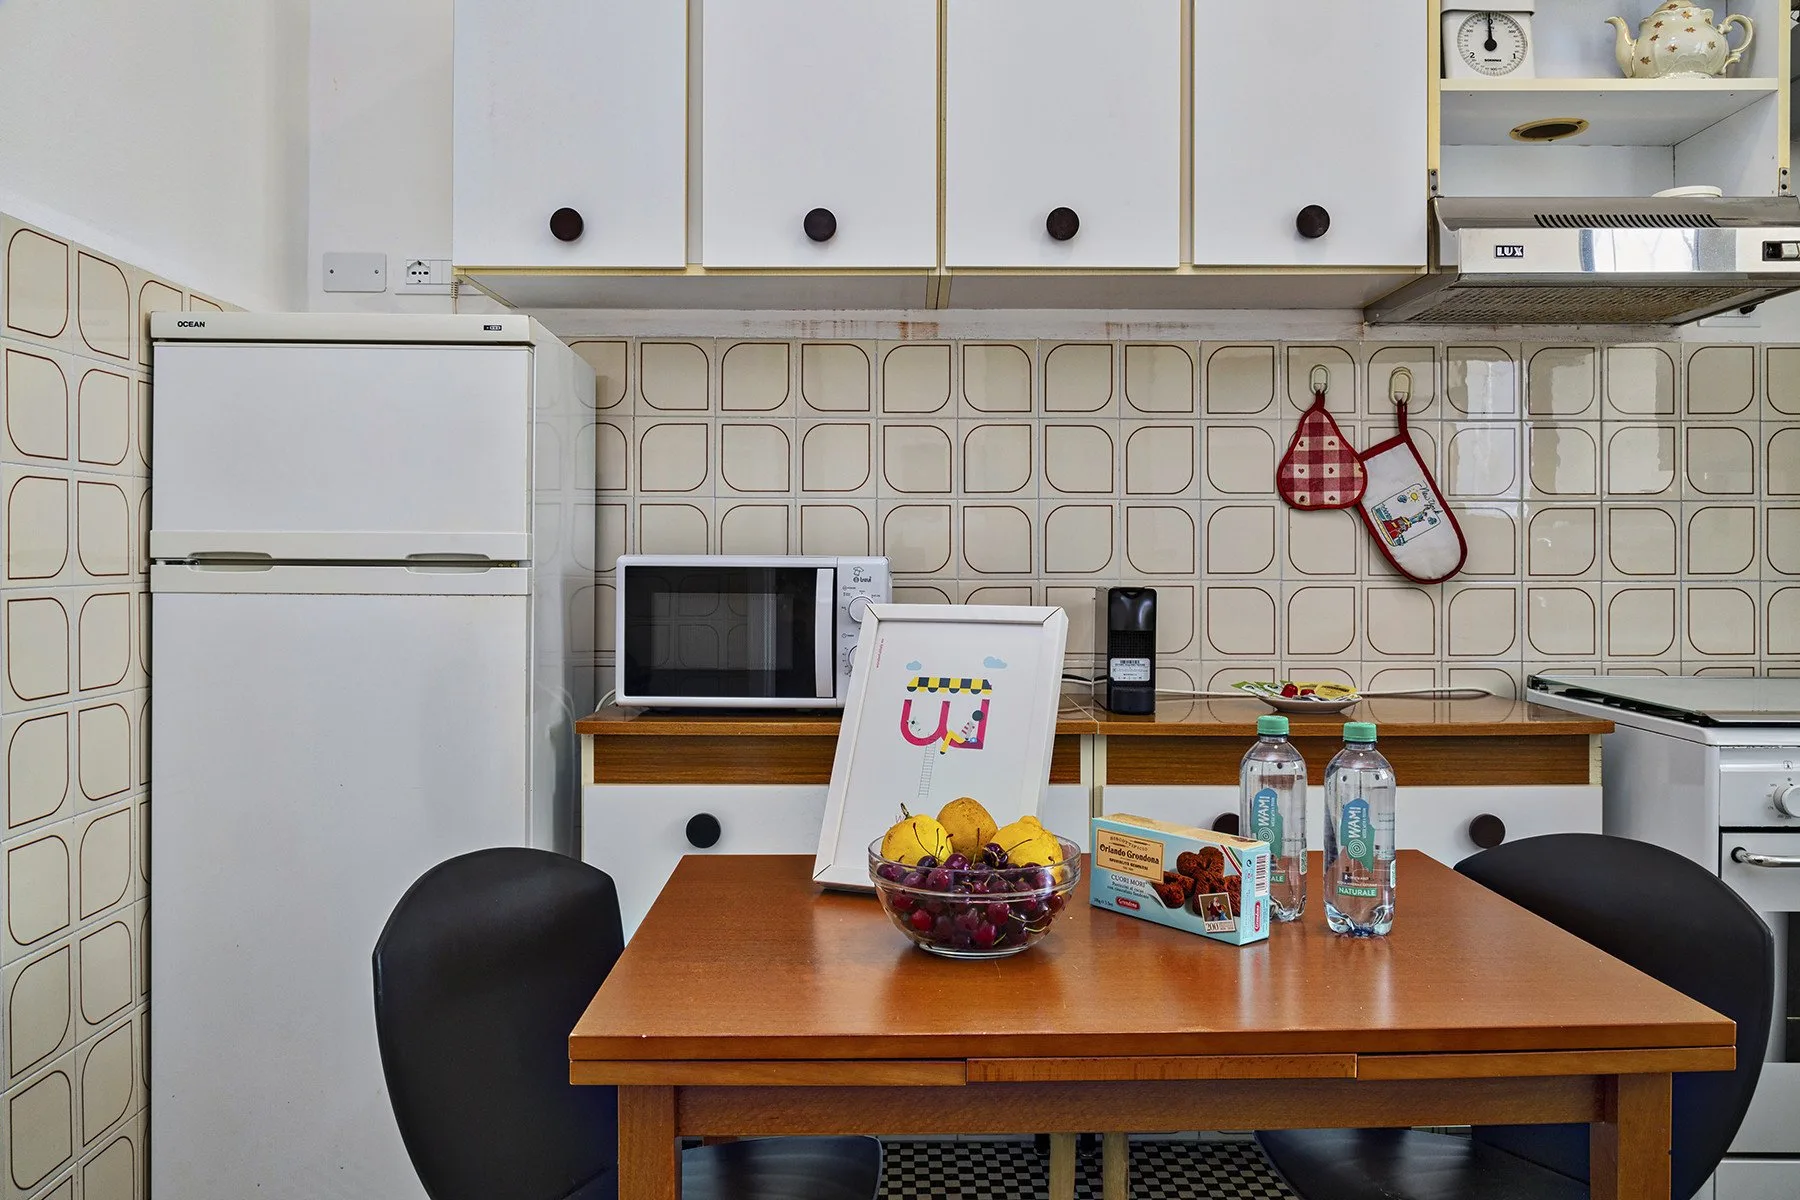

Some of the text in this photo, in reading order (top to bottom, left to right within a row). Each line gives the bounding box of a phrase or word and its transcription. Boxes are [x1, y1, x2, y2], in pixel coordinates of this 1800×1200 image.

[1496, 246, 1523, 256] LUX
[177, 320, 206, 328] OCEAN
[1258, 796, 1271, 826] WAMI
[1348, 806, 1362, 839] WAMI
[1099, 843, 1126, 857] Orlando
[1126, 849, 1160, 865] Grondona
[1338, 887, 1377, 897] NATURALE
